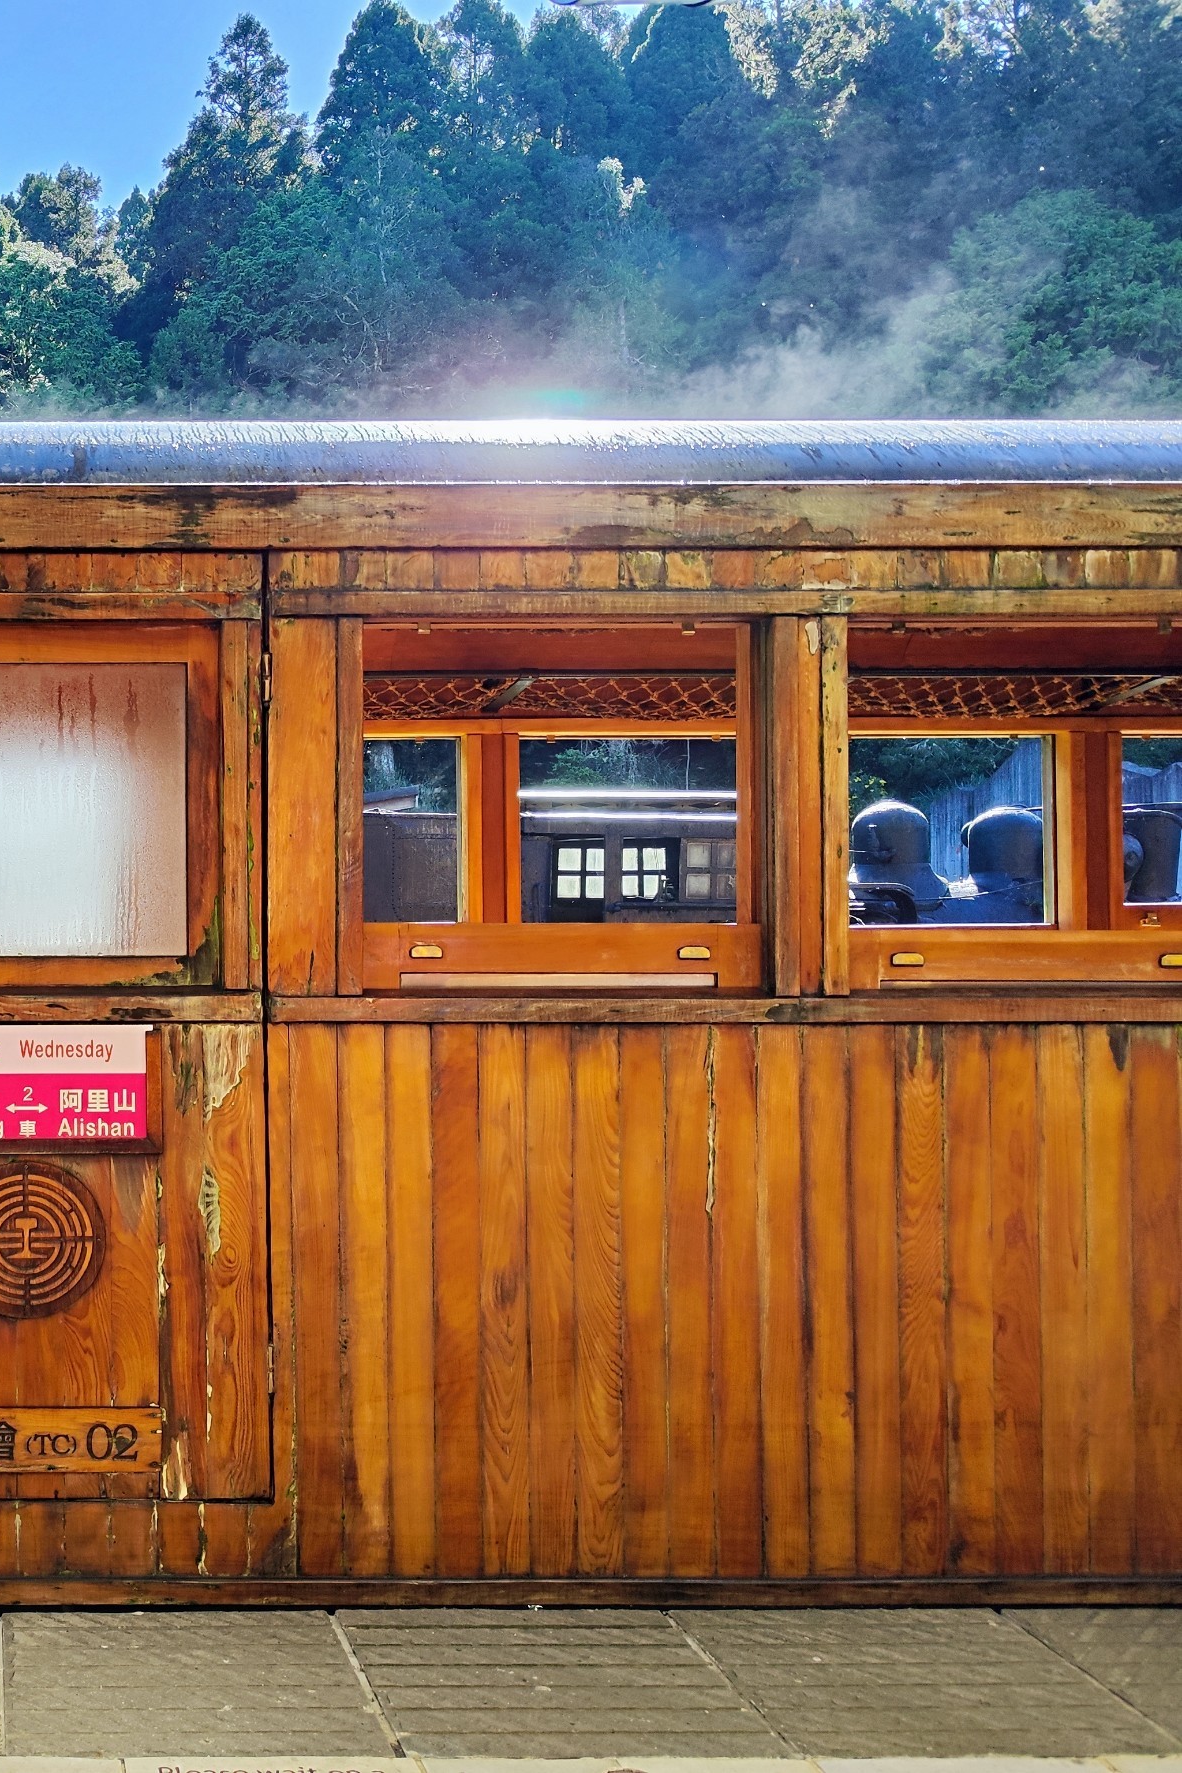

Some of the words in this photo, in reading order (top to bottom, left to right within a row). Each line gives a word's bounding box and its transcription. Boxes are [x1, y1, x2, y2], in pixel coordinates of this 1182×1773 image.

[19, 1039, 114, 1062] Wednesday
[22, 1086, 34, 1102] 2
[59, 1088, 136, 1114] 阿里山
[18, 1120, 37, 1138] 車
[57, 1117, 135, 1137] Alishan
[26, 1434, 77, 1456] (TC)
[86, 1423, 138, 1461] 02
